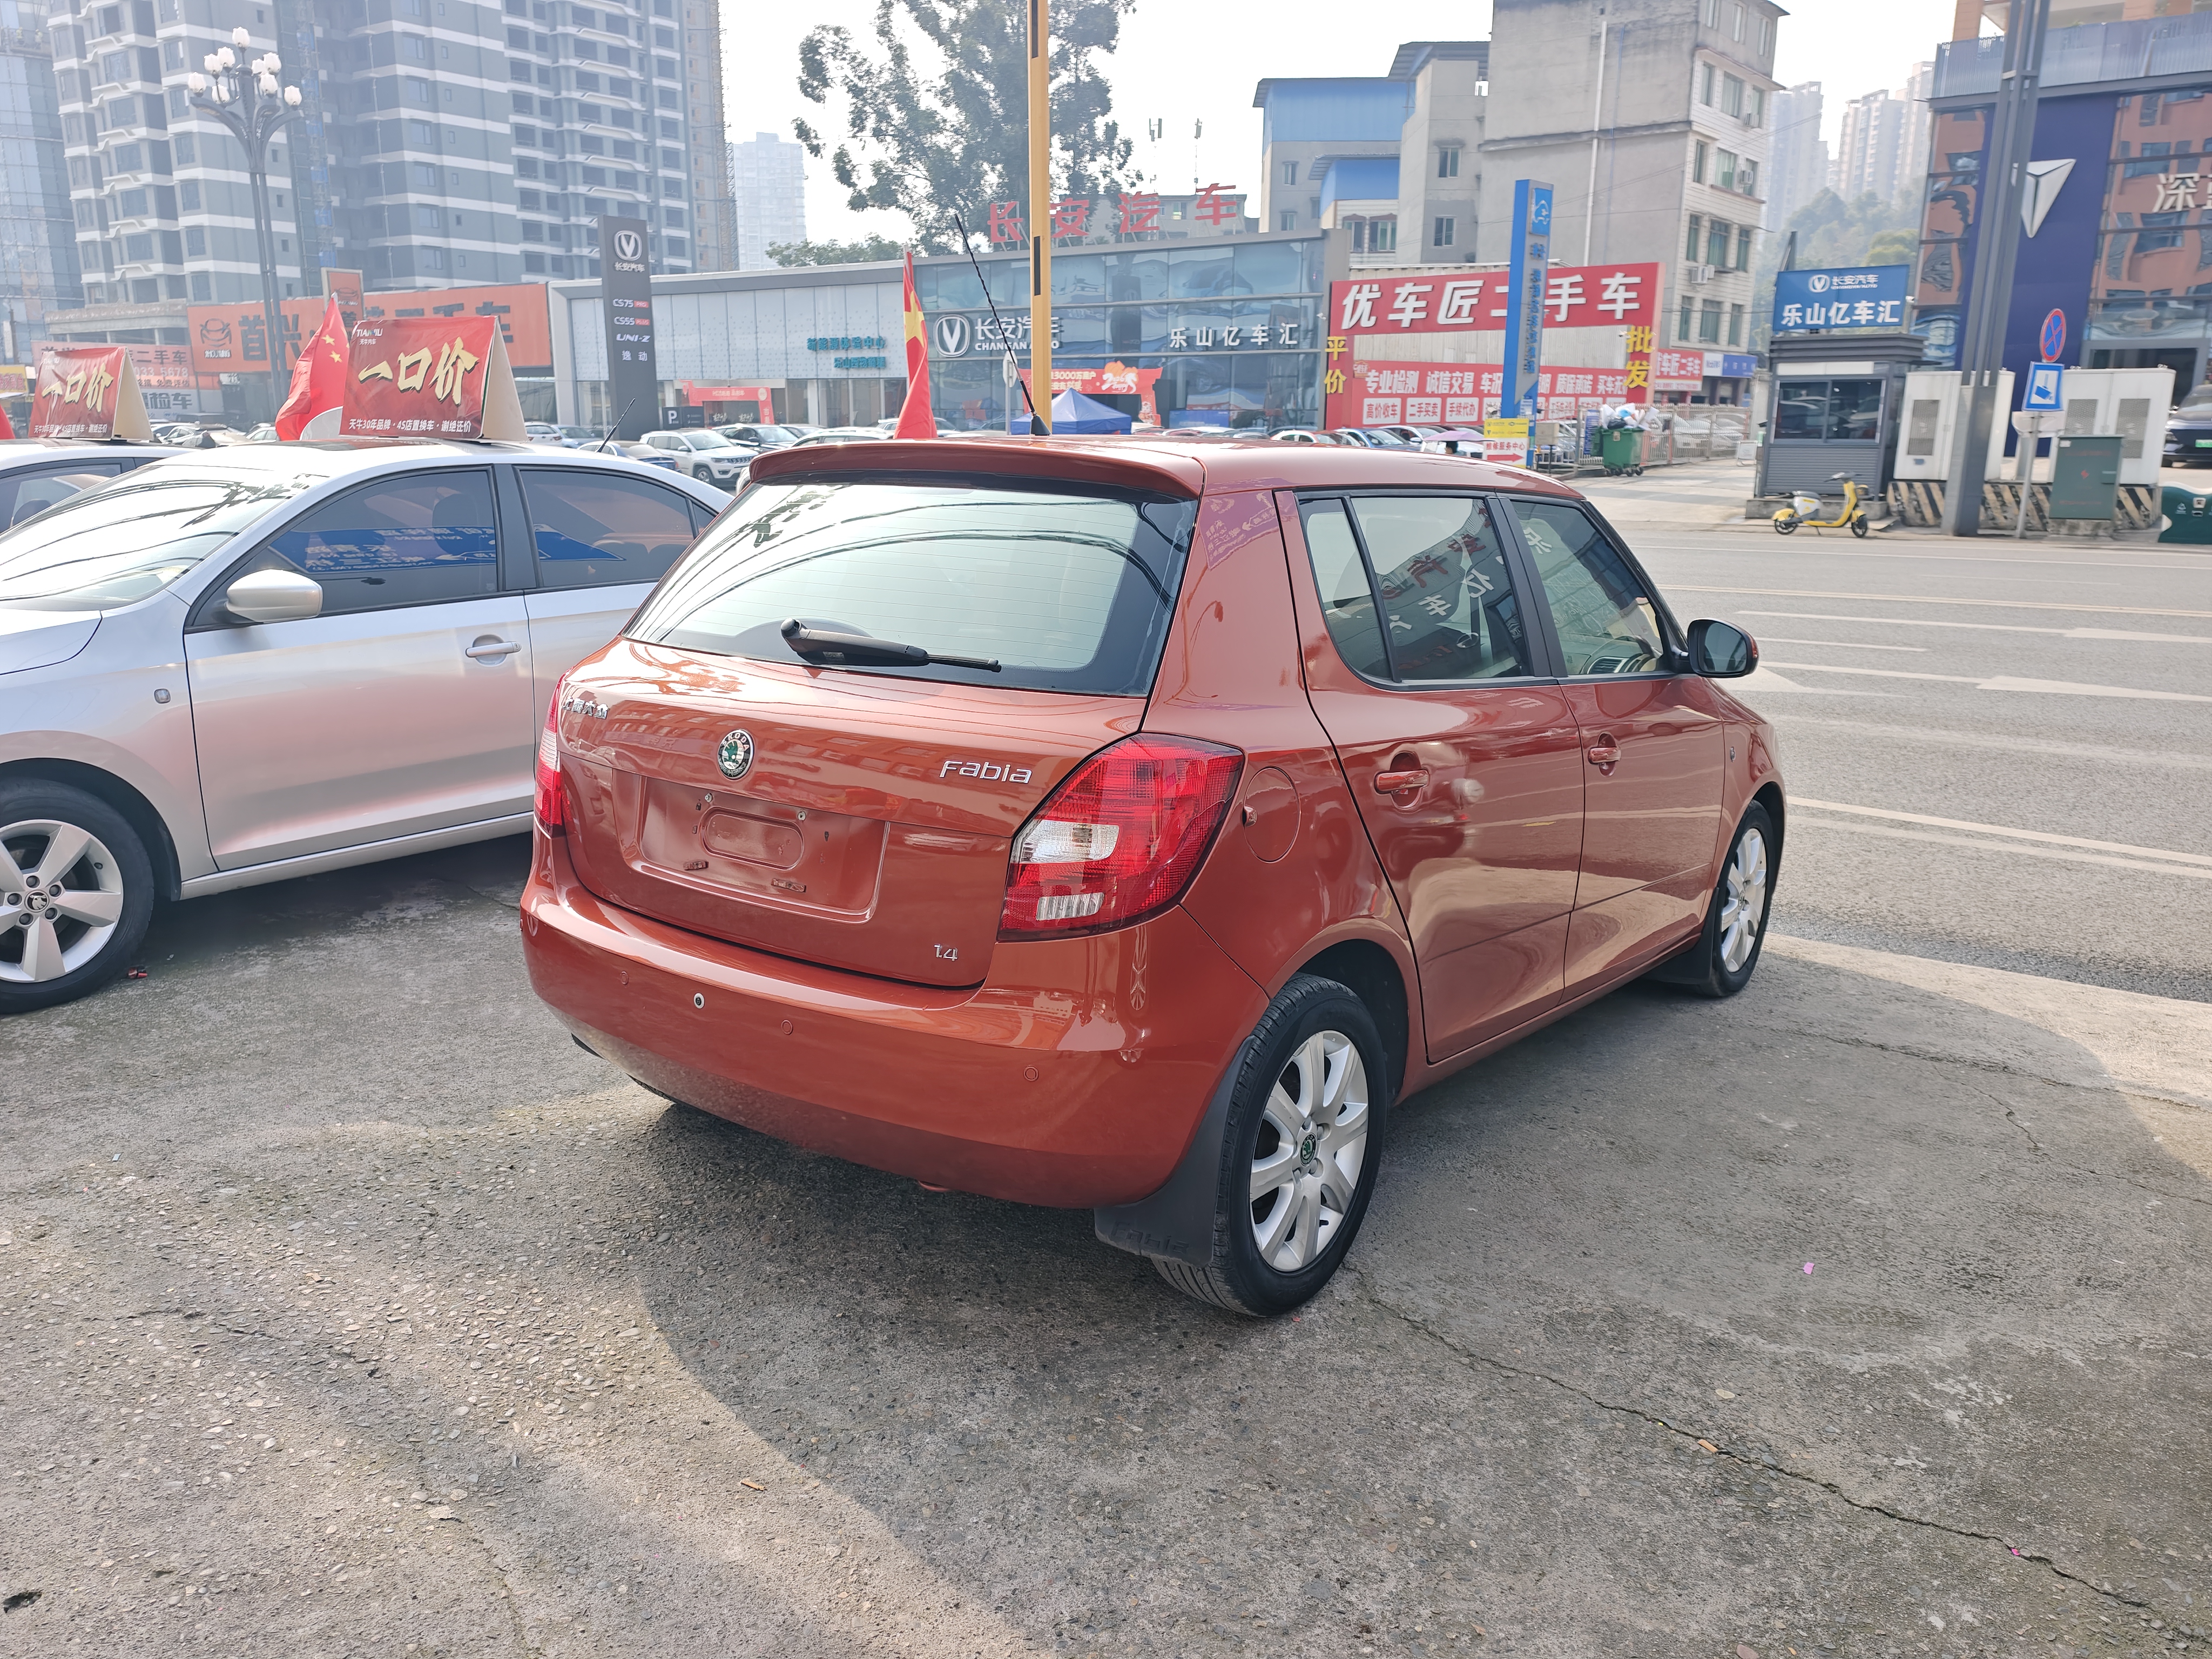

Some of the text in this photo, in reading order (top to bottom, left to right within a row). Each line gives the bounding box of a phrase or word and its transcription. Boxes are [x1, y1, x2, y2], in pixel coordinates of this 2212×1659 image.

[2152, 173, 2212, 213] 深
[988, 183, 1237, 243] 长安汽车
[612, 298, 633, 308] CS75
[1781, 300, 1901, 327] 乐山亿车汇
[613, 316, 635, 326] CS55
[616, 333, 651, 343] UNI-Z
[975, 341, 1027, 350] CHANGAN
[1170, 322, 1298, 348] 乐山亿车汇
[1324, 336, 1348, 395] 平价
[1624, 326, 1656, 388] 批发
[160, 367, 188, 377] 5678
[358, 336, 480, 408] 一口价
[1365, 370, 1419, 394] 专业检测
[1426, 371, 1474, 394] 诚信交易
[42, 362, 114, 413] 一口价
[1366, 403, 1398, 419] 高价收车
[1409, 403, 1439, 417] 二手买卖
[939, 760, 1032, 784] Fabia
